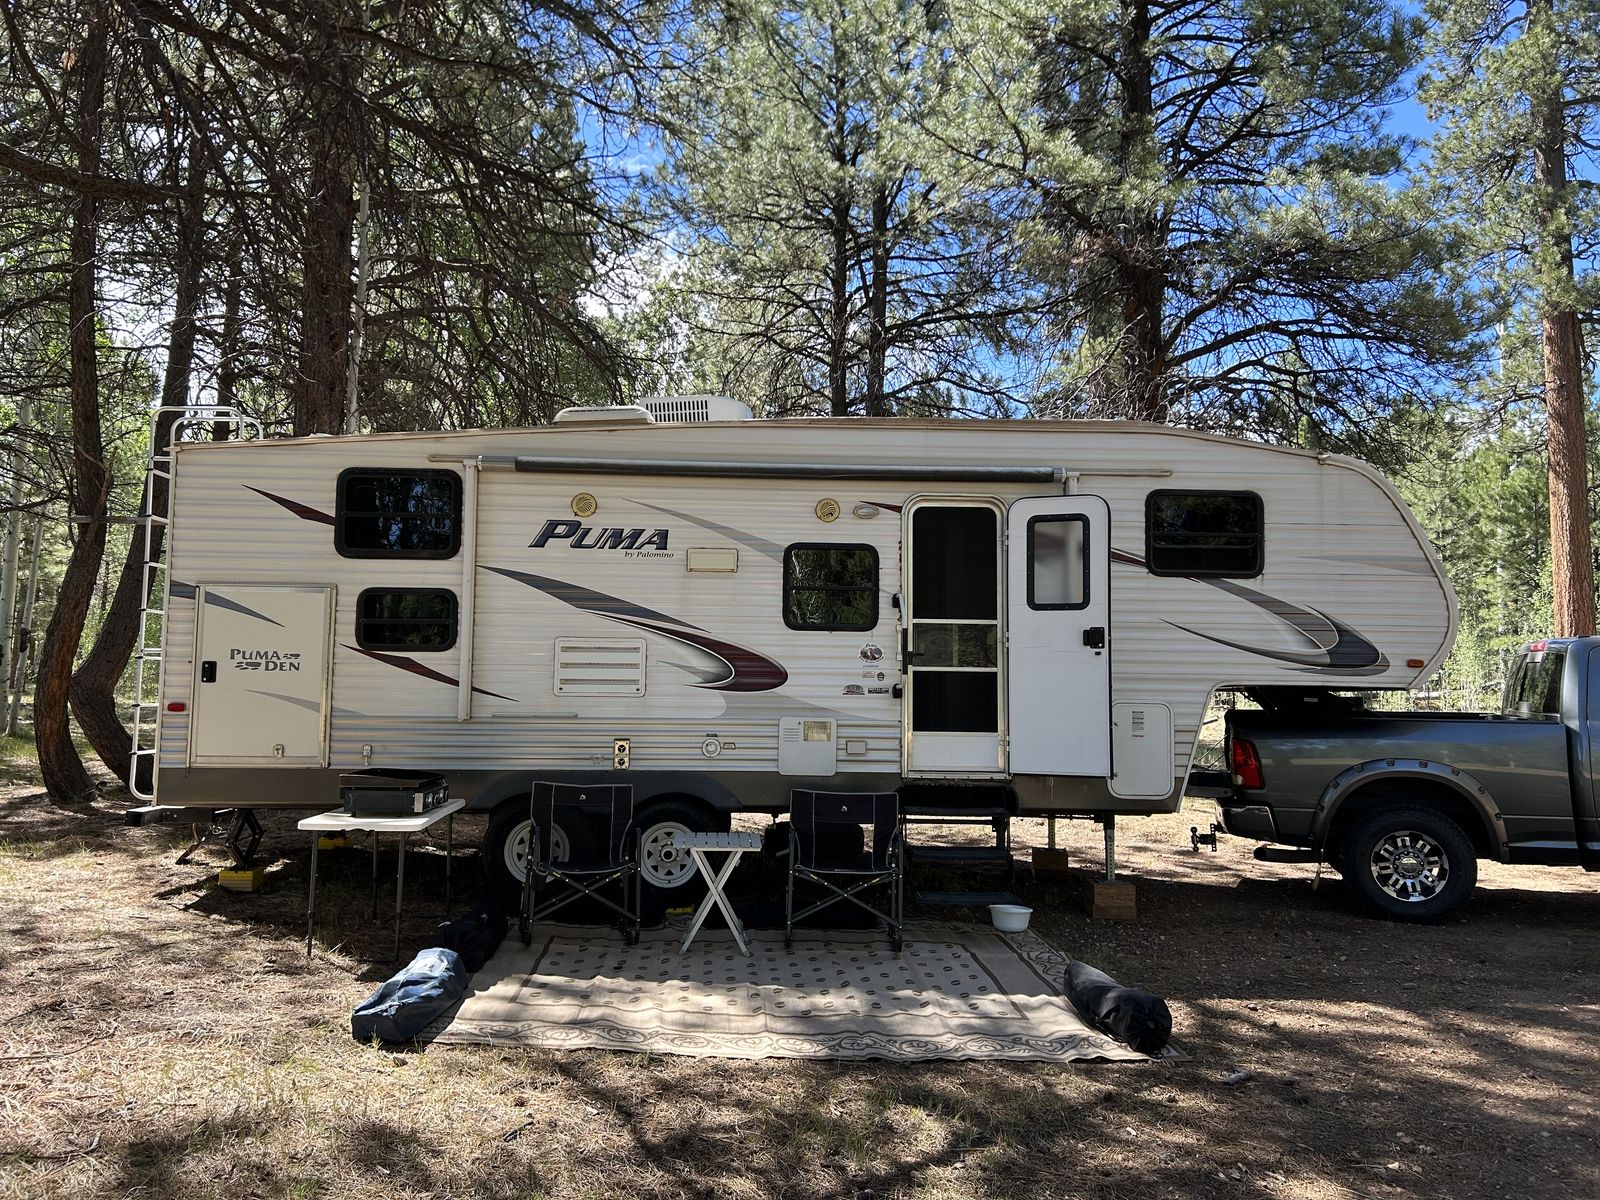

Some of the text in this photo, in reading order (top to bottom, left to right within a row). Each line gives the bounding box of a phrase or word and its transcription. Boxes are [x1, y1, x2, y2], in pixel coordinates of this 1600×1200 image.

[528, 519, 669, 551] PUMA
[624, 551, 674, 559] by Palomino
[229, 648, 282, 660] PUMA
[264, 660, 301, 672] DEN
